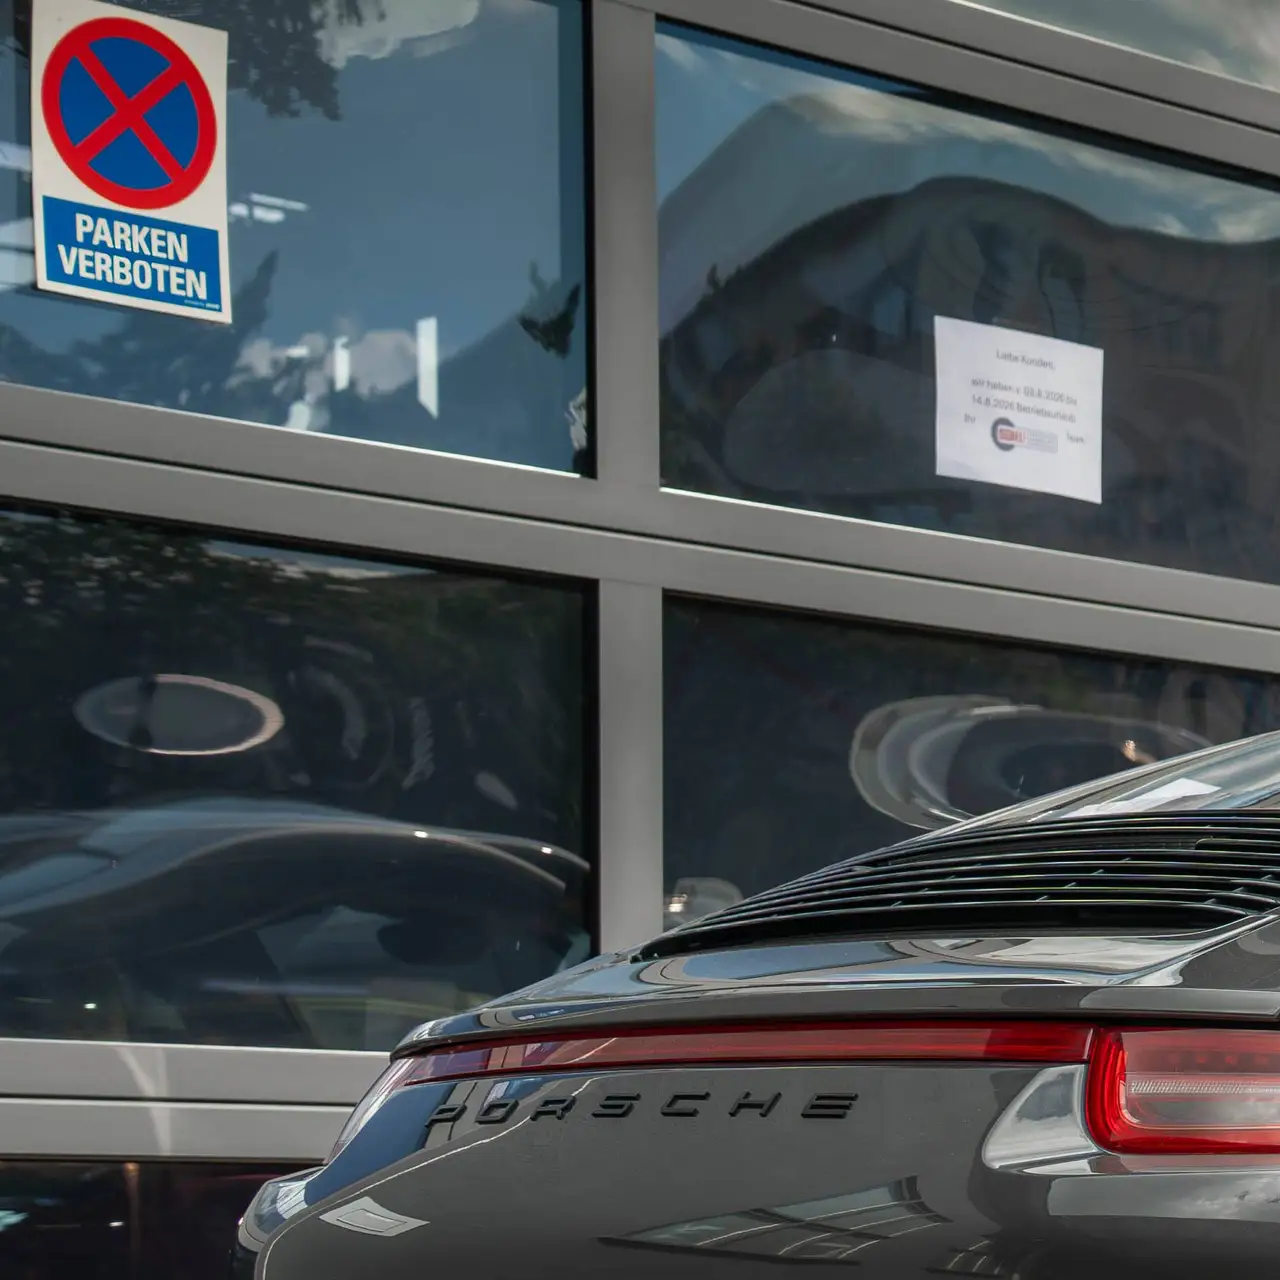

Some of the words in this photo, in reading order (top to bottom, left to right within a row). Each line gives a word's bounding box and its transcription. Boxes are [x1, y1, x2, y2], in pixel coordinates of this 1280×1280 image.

[75, 212, 189, 264] PARKEN
[57, 245, 207, 300] VERBOTEN
[424, 1091, 859, 1129] PORSCHE
